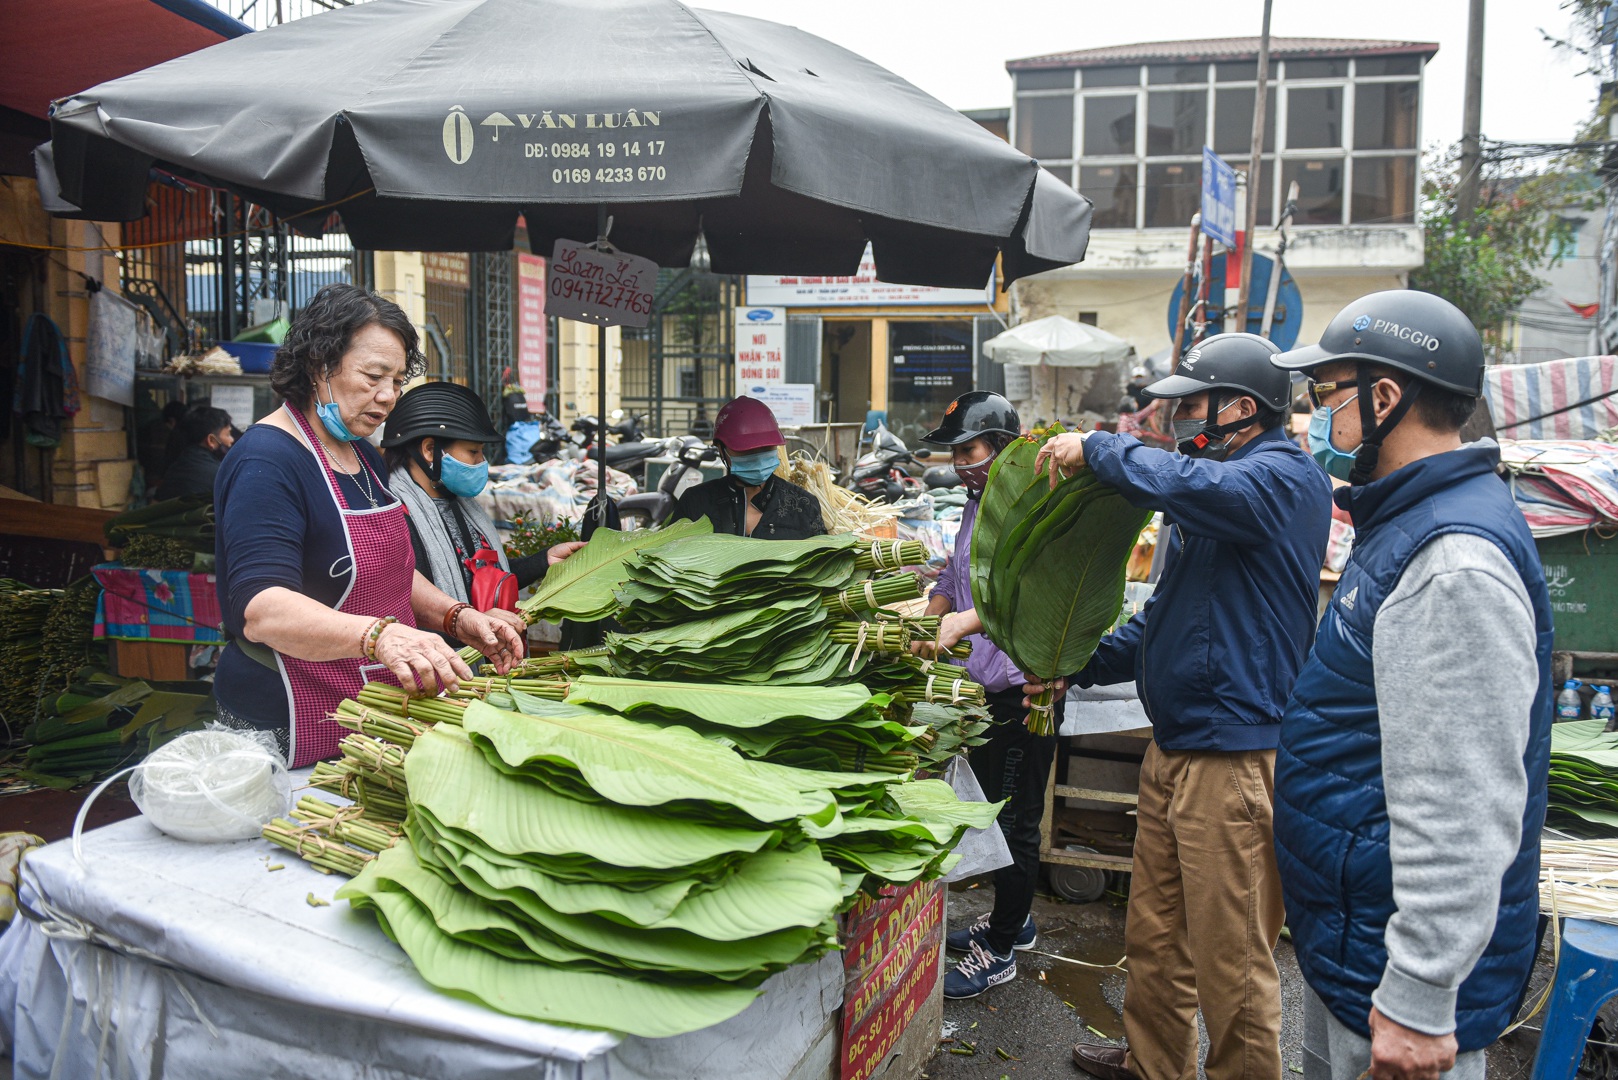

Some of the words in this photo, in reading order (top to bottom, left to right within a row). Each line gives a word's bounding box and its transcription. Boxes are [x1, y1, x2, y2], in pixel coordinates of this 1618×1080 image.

[516, 110, 577, 128] VĂN
[585, 108, 661, 128] LUÂN
[551, 143, 590, 158] 0984
[597, 142, 616, 158] 19
[622, 141, 641, 157] 14
[647, 140, 665, 156] 17
[552, 168, 591, 183] 0169
[595, 167, 634, 183] 4233
[638, 165, 667, 181] 670
[551, 276, 654, 315] 0947727769
[866, 1038, 887, 1077] 0947
